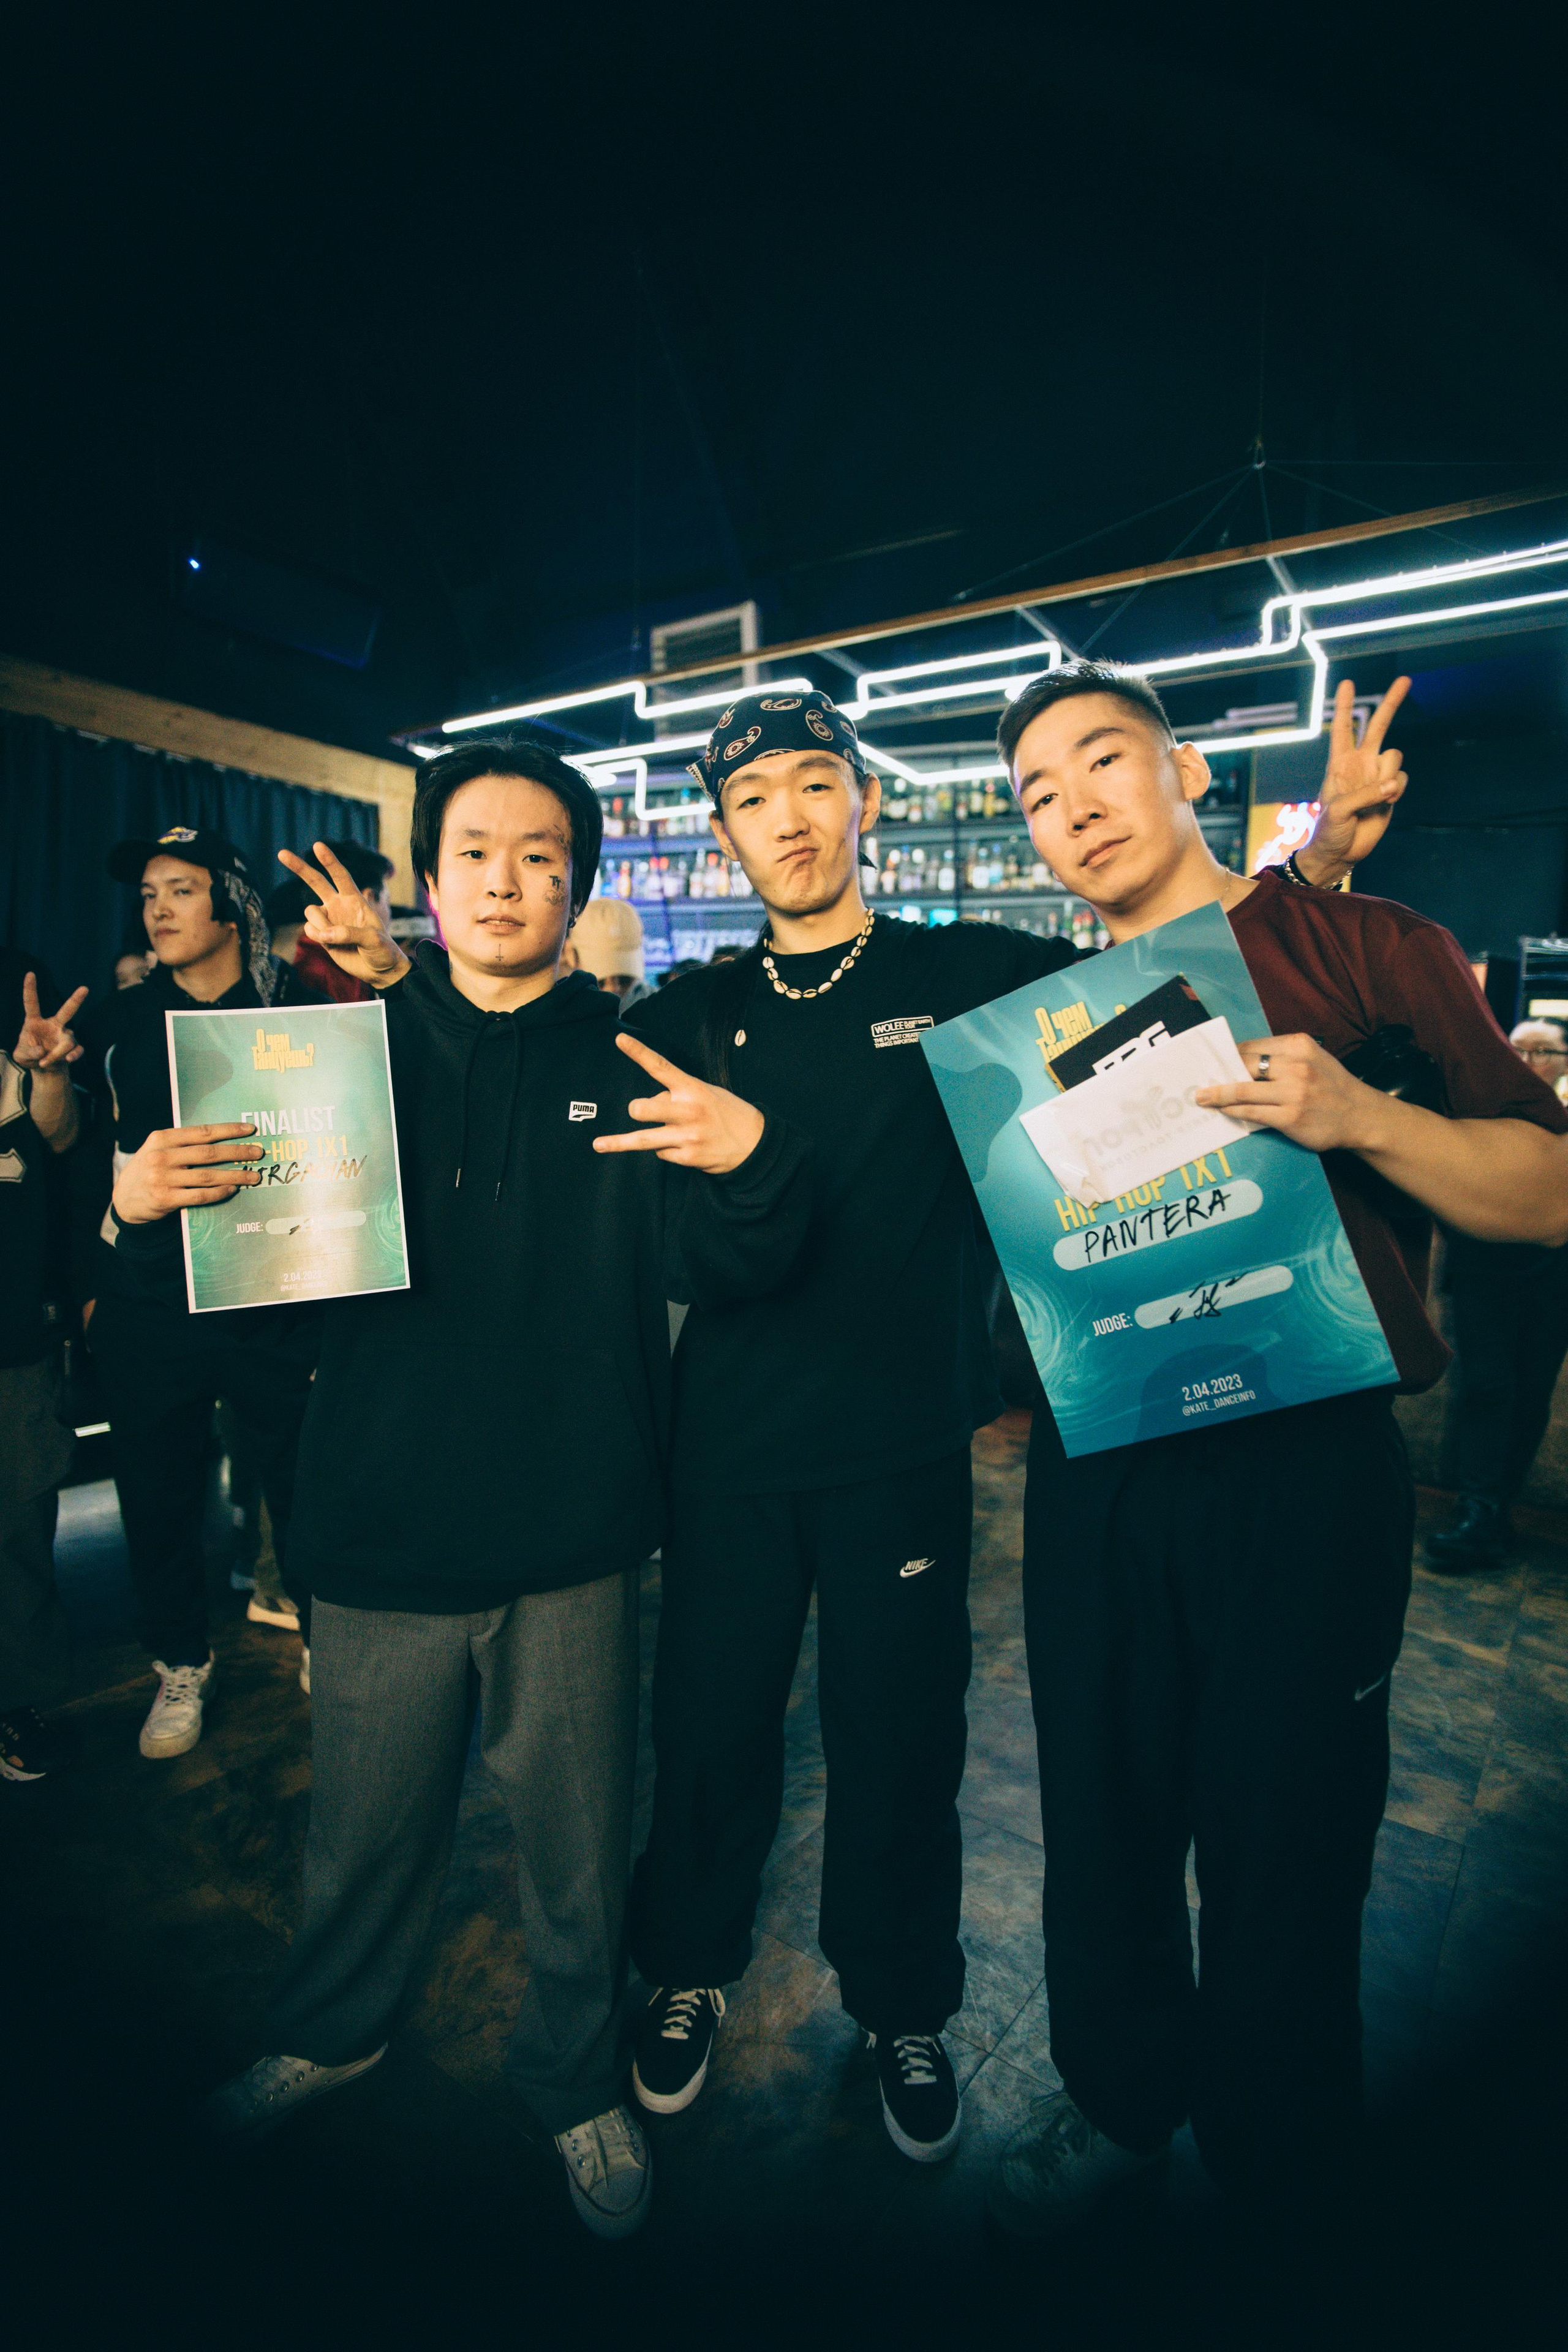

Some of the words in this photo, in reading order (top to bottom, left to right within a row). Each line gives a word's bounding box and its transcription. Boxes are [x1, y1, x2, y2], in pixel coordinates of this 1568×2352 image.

[873, 1021, 905, 1034] WOLEE
[573, 1104, 594, 1113] PUMA
[235, 1221, 264, 1234] JUDGE:
[1084, 1188, 1231, 1263] PANTERA
[1092, 1313, 1133, 1337] JUDGE:
[1182, 1374, 1243, 1401] 2.04.2023
[1182, 1390, 1256, 1416] @KATE_DANCEINFO
[905, 1558, 929, 1570] NIKE
